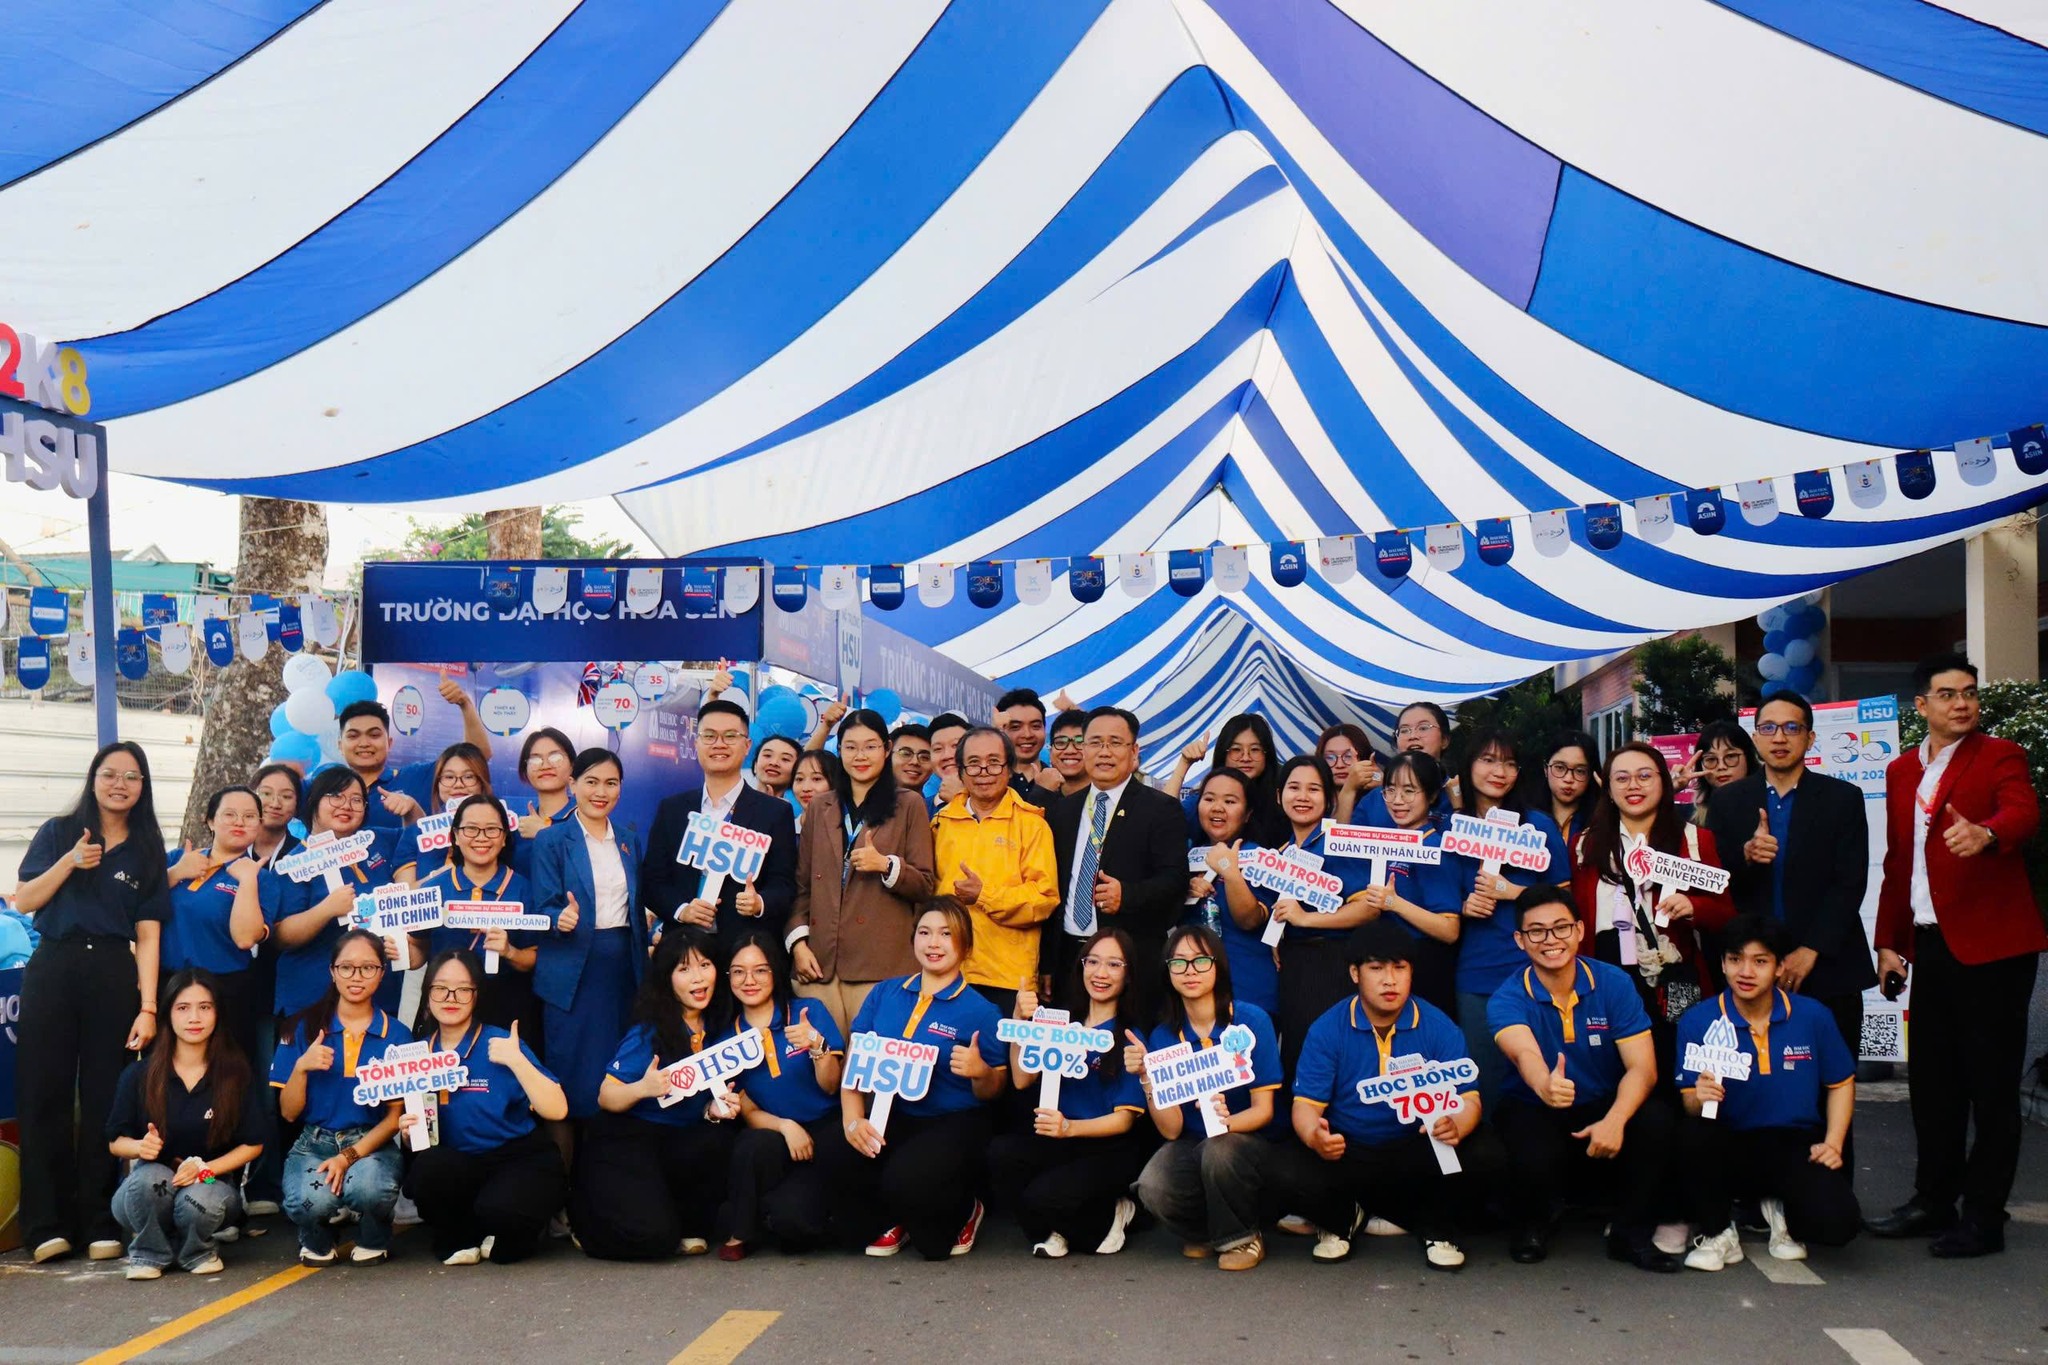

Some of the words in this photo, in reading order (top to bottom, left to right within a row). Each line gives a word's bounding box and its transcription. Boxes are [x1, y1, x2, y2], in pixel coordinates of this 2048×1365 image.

[0, 323, 91, 416] 2K8
[1279, 563, 1298, 571] ASIIN
[380, 598, 490, 621] TRƯỜNG
[842, 629, 860, 668] HSU
[1862, 707, 1893, 720] HSU
[1861, 769, 1885, 780] 202
[325, 841, 351, 855] THỰC
[353, 833, 372, 846] TẬP
[691, 814, 718, 833] TÔI
[720, 824, 768, 849] CHỌN
[1455, 819, 1493, 839] TINH
[1496, 827, 1542, 849] THẦN
[292, 865, 315, 879] VIỆC
[317, 858, 338, 871] LÀM
[339, 850, 366, 863] 100%
[680, 830, 762, 880] HSU
[1363, 845, 1379, 857] TRỊ
[1382, 846, 1413, 858] NHÂN
[1416, 849, 1438, 862] LỰC
[1444, 836, 1507, 861] DOANH
[1509, 850, 1546, 870] CHỦ
[1257, 850, 1289, 873] TÔN
[1289, 864, 1339, 893] TRỌNG
[1654, 864, 1724, 891] UNIVERSITY
[1656, 856, 1670, 867] DE
[1671, 860, 1726, 882] MONTFORT
[378, 895, 408, 911] CÔNG
[410, 888, 438, 909] NGHỆ
[1244, 866, 1266, 884] SỰ
[1265, 874, 1306, 898] KHÁC
[1307, 889, 1339, 911] BIỆT
[380, 910, 400, 928] TÀI
[402, 905, 440, 926] CHÍNH
[491, 916, 513, 926] KINH
[515, 917, 548, 927] DOANH
[1001, 1022, 1045, 1042] HỌC
[696, 1035, 760, 1081] HSU
[854, 1031, 881, 1052] TÔI
[885, 1041, 936, 1063] CHỌN
[1022, 1044, 1084, 1074] 50%
[360, 1063, 395, 1082] TÔN
[398, 1054, 457, 1075] TRỌNG
[845, 1053, 930, 1097] HSU
[1151, 1064, 1174, 1084] TÀI
[1175, 1051, 1219, 1077] CHÍNH
[1362, 1078, 1407, 1098] HỌC
[1411, 1064, 1473, 1088] BỔNG
[1720, 1065, 1747, 1079] SEN
[357, 1084, 380, 1103] SỰ
[382, 1075, 428, 1098] KHÁC
[431, 1070, 465, 1089] BIỆT
[1157, 1081, 1195, 1105] NGÂN
[1196, 1069, 1236, 1093] HÀNG
[1392, 1091, 1458, 1119] 70%
